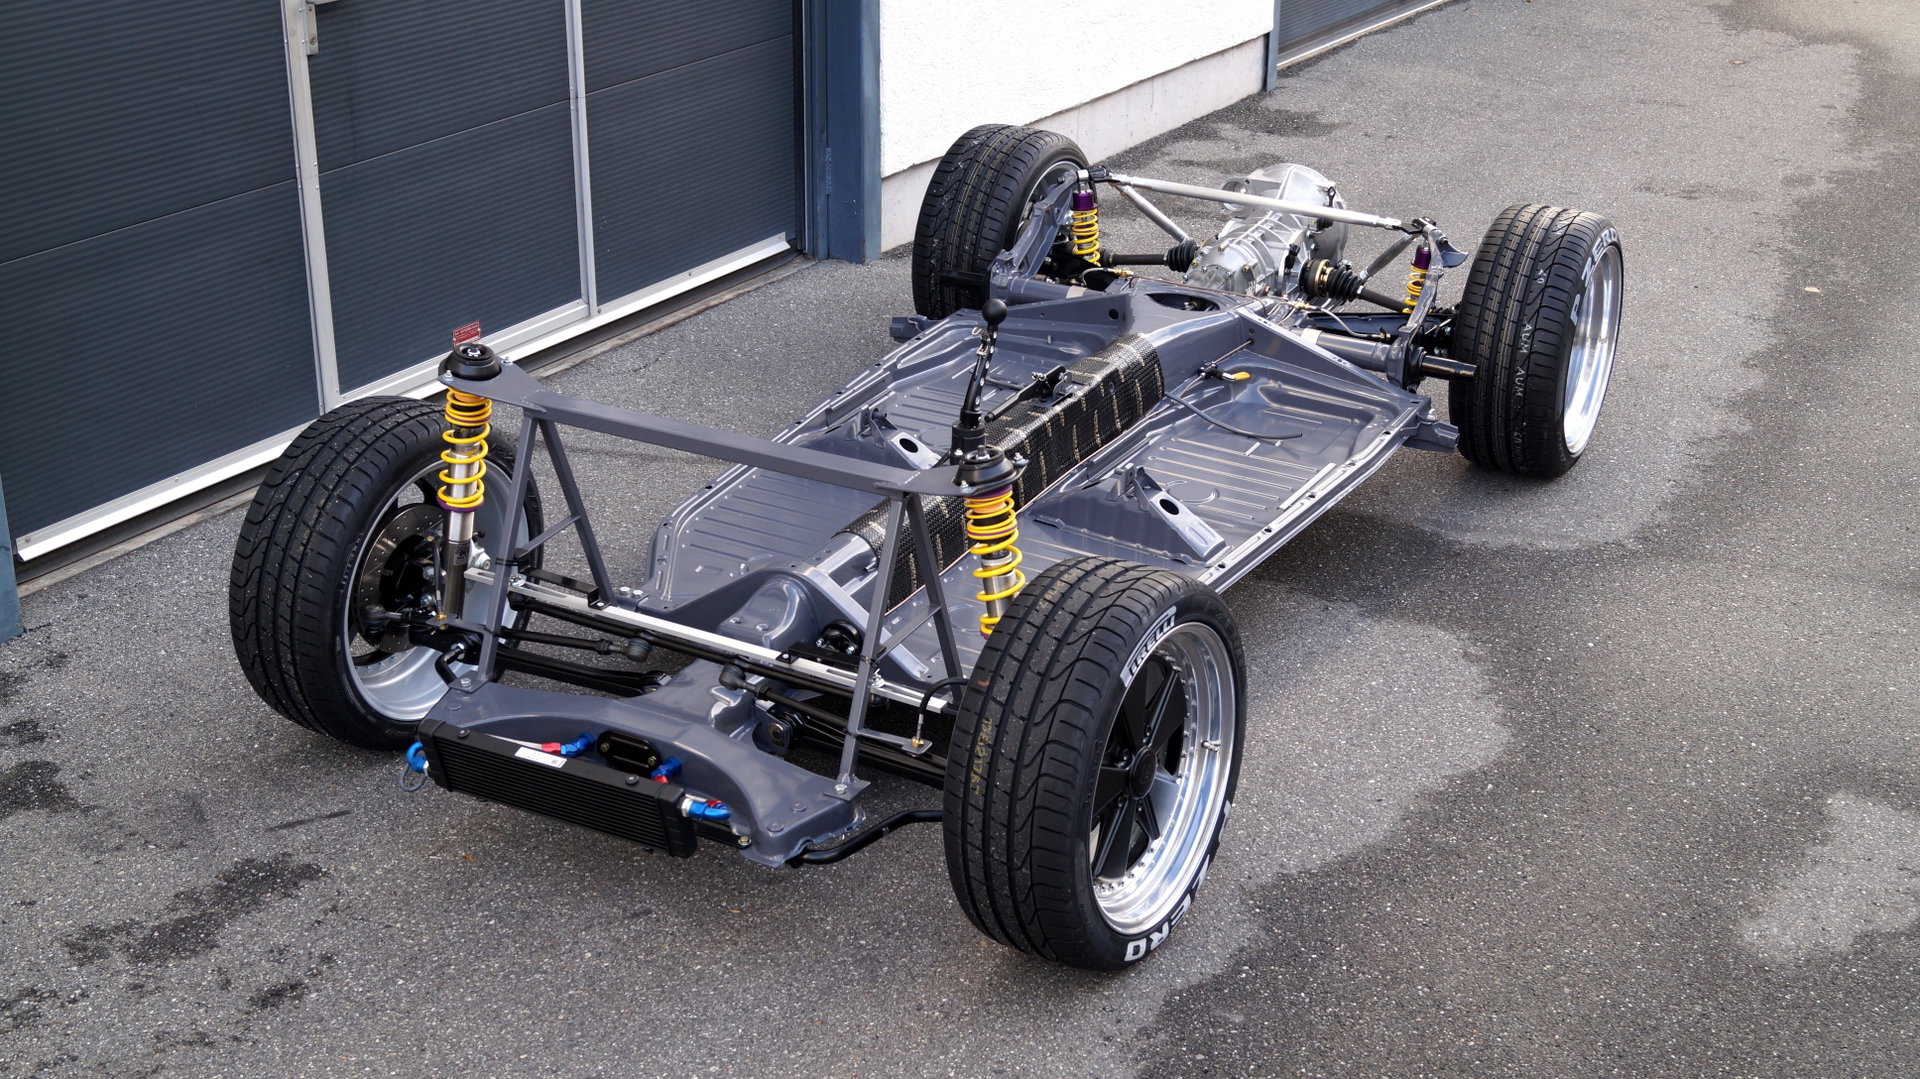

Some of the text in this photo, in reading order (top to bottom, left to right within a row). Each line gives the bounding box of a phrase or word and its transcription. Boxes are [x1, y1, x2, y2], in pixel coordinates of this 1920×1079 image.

[1570, 228, 1619, 326] P ZERO
[1515, 321, 1532, 397] AUM AUM
[1120, 605, 1177, 688] PIRELLI
[1124, 854, 1210, 962] ZERO
